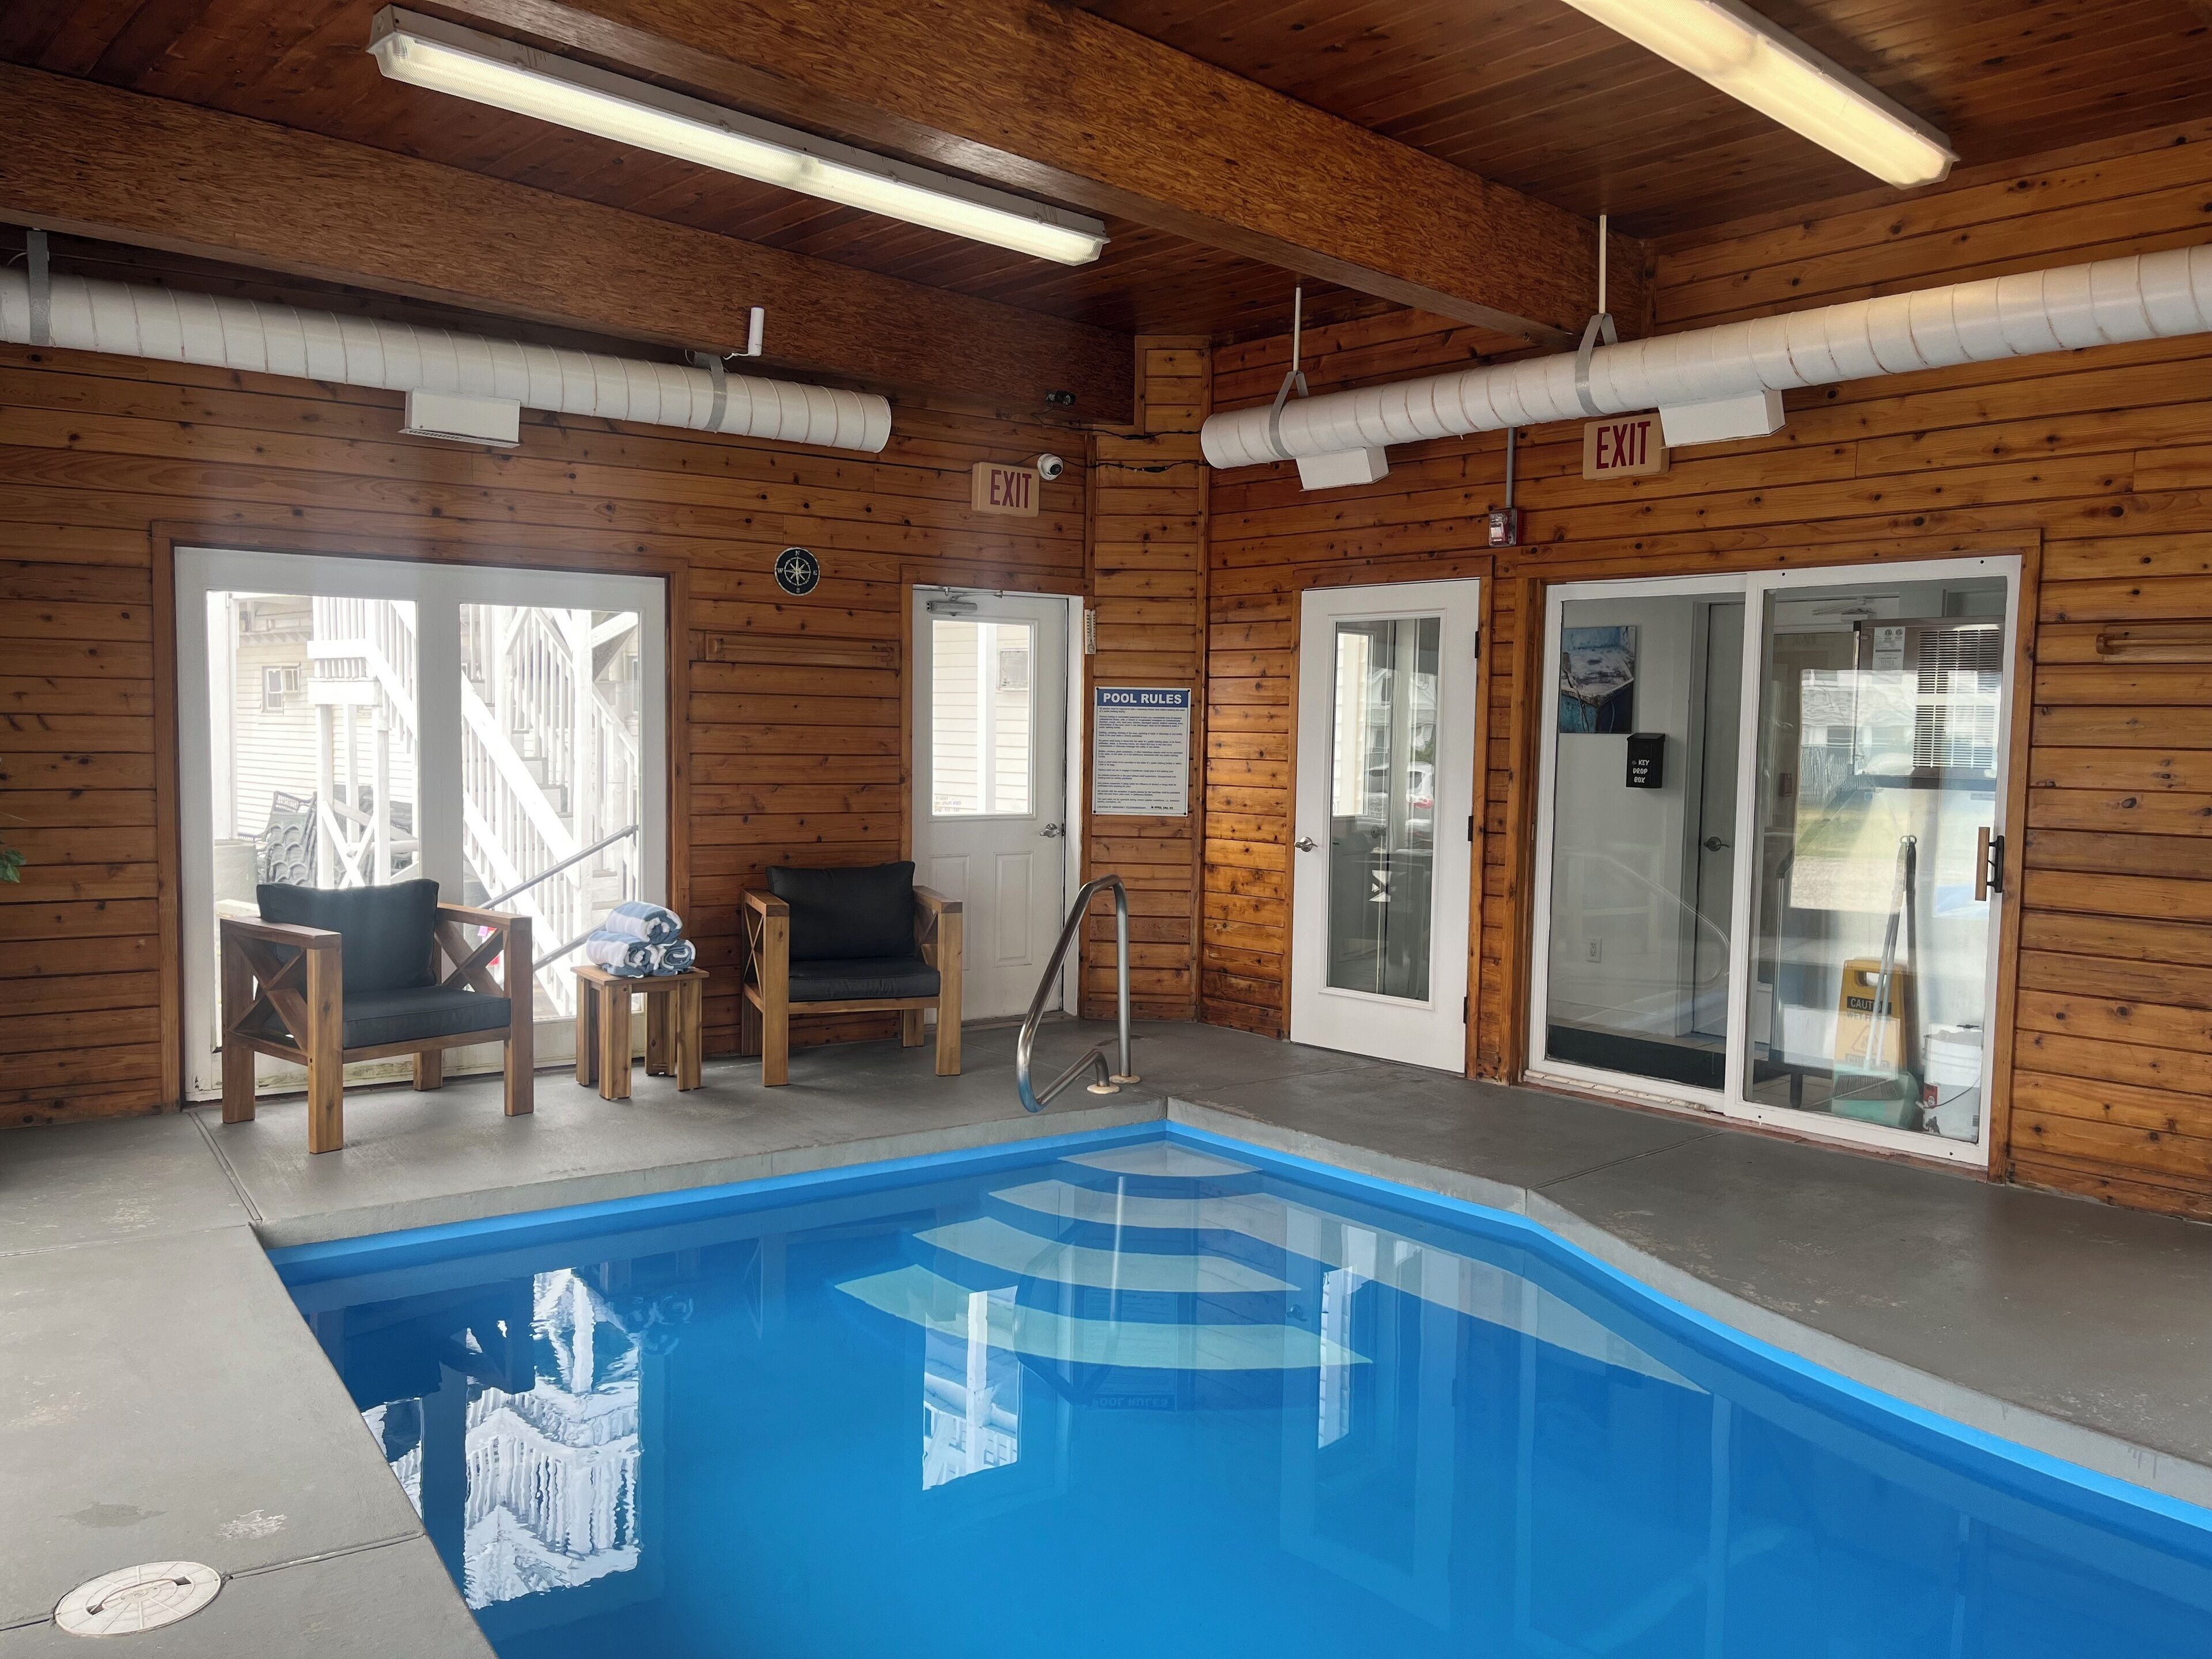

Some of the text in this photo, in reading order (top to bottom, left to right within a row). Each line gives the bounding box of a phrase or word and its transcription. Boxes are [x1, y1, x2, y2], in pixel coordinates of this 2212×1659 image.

[1596, 421, 1651, 469] EXIT
[990, 469, 1032, 509] EXIT
[1103, 693, 1182, 704] POOL RULES
